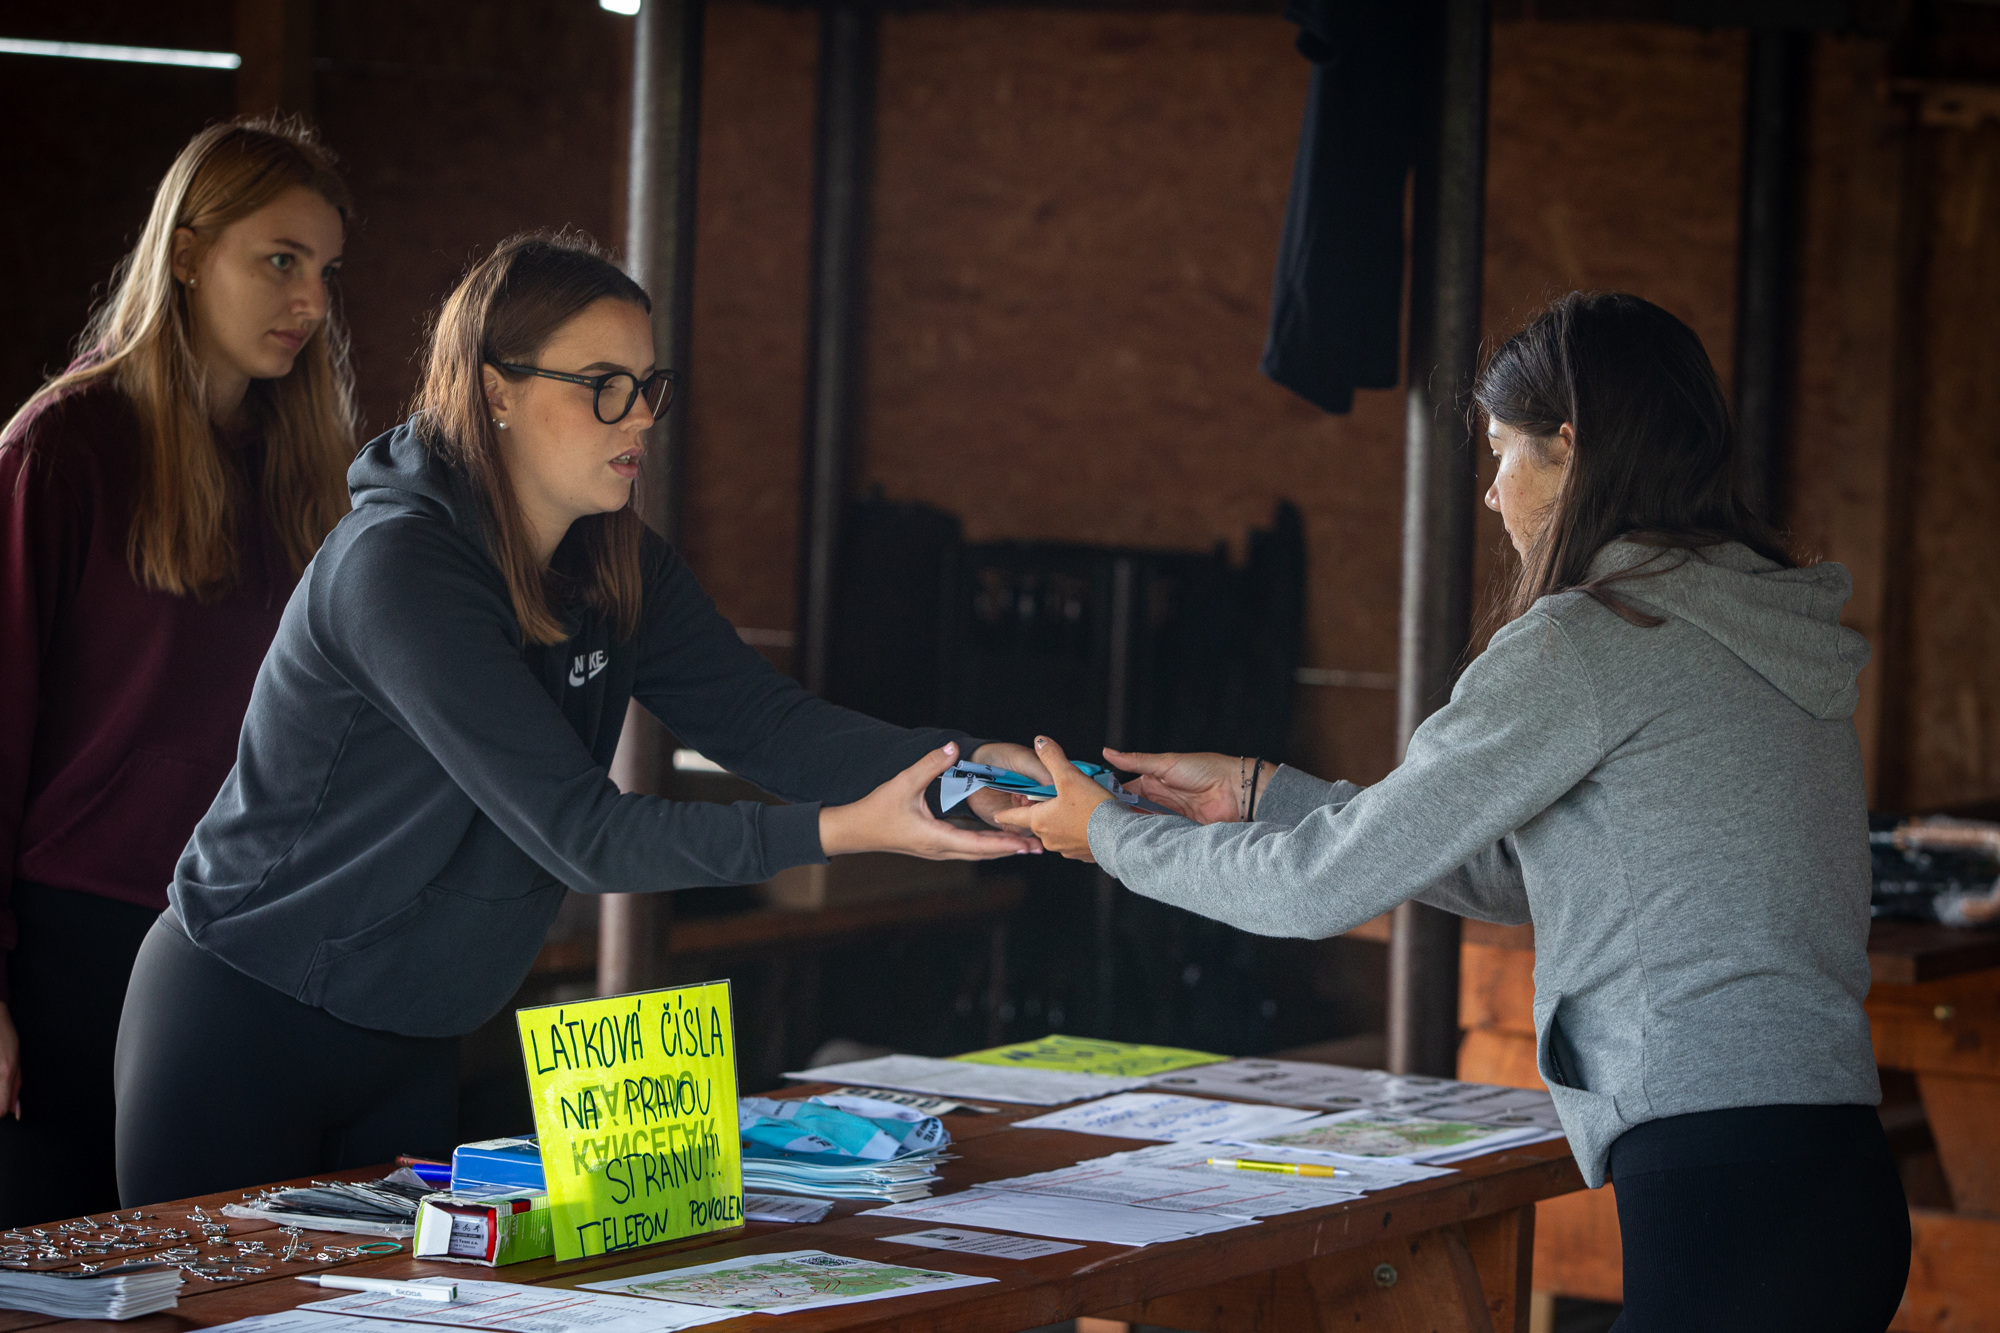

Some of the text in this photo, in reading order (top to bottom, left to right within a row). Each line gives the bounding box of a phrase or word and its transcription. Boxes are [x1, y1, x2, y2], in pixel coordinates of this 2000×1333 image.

[574, 650, 604, 674] NKE
[531, 995, 724, 1075] LÁTKOVÁ ČÍSLA
[561, 1077, 711, 1129] NA PRAVOU
[606, 1133, 721, 1204] STRANU!!!
[577, 1209, 668, 1257] TELEFON
[690, 1197, 744, 1226] POVOLEN
